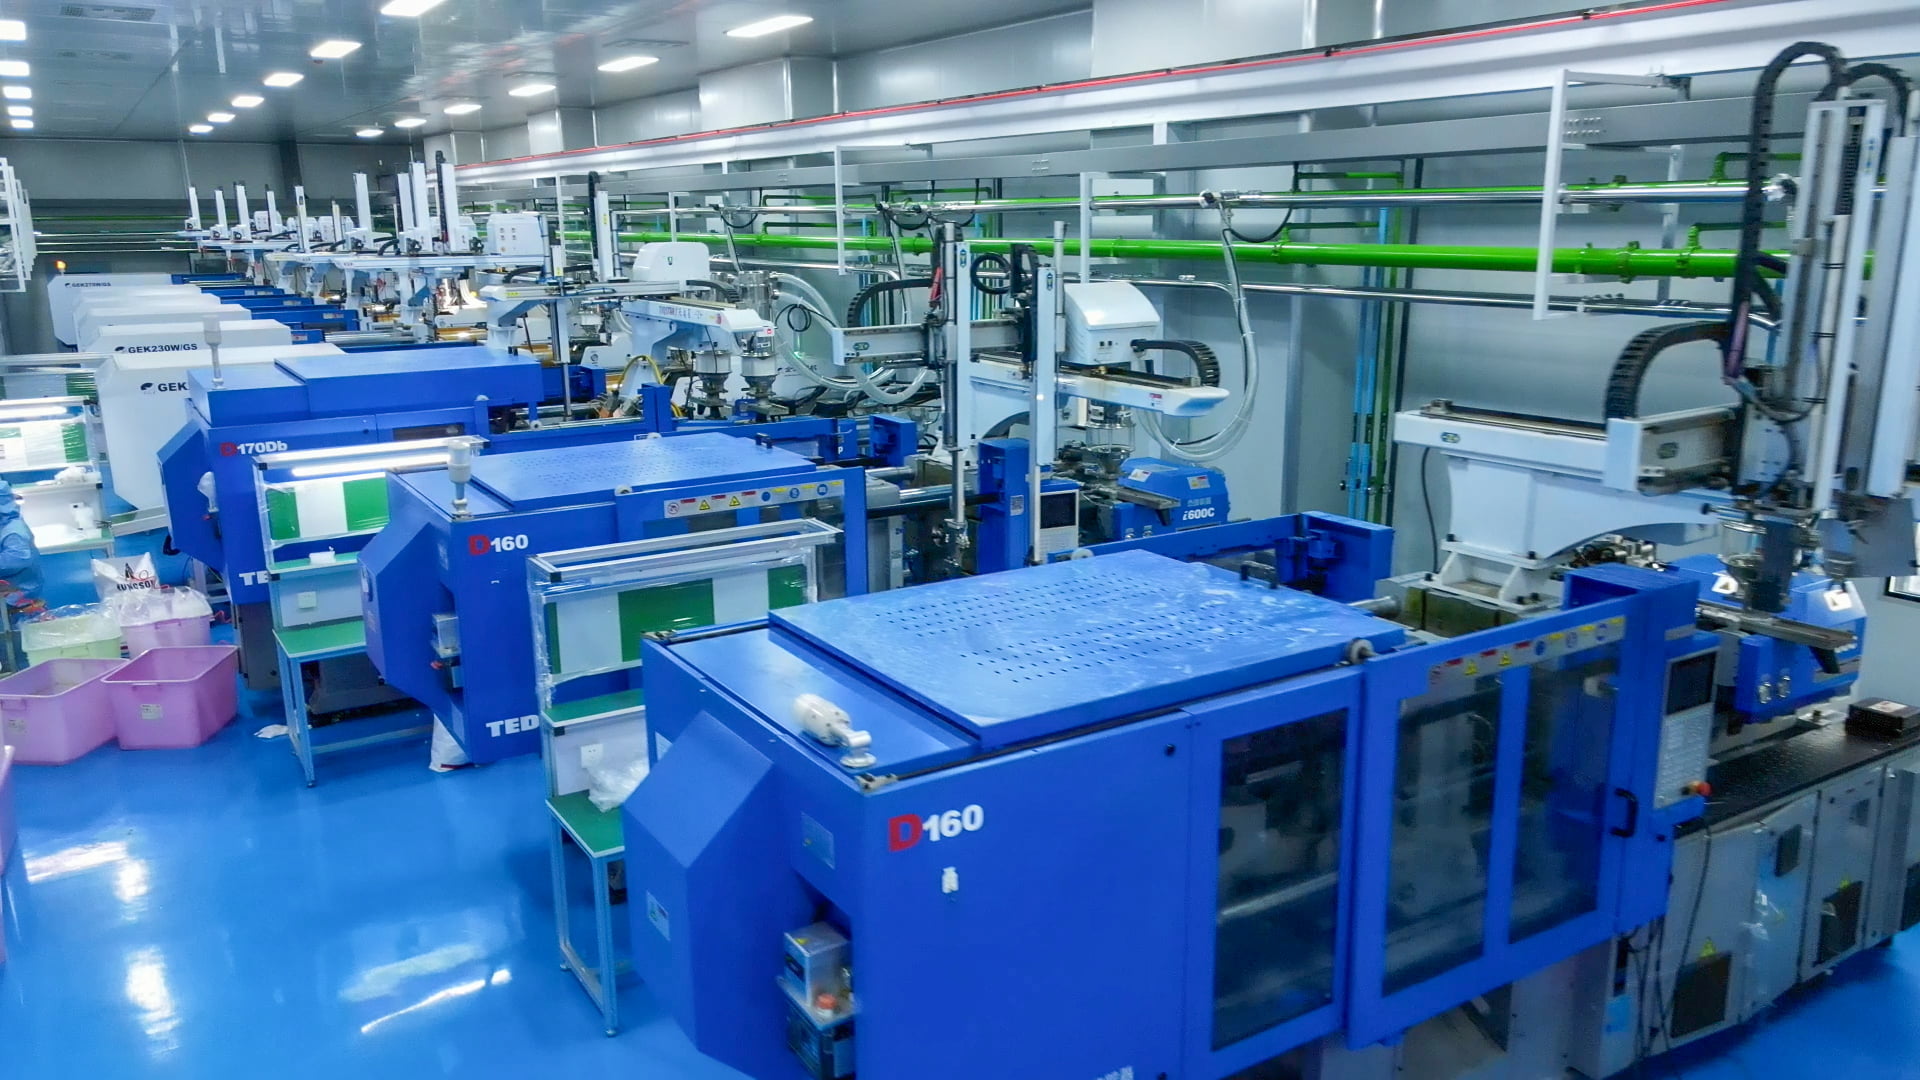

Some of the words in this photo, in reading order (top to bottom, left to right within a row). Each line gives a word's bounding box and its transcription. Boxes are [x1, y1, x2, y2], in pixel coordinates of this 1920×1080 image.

[128, 343, 198, 354] GEK230W/GS
[468, 533, 529, 556] D160
[888, 804, 984, 853] D160
